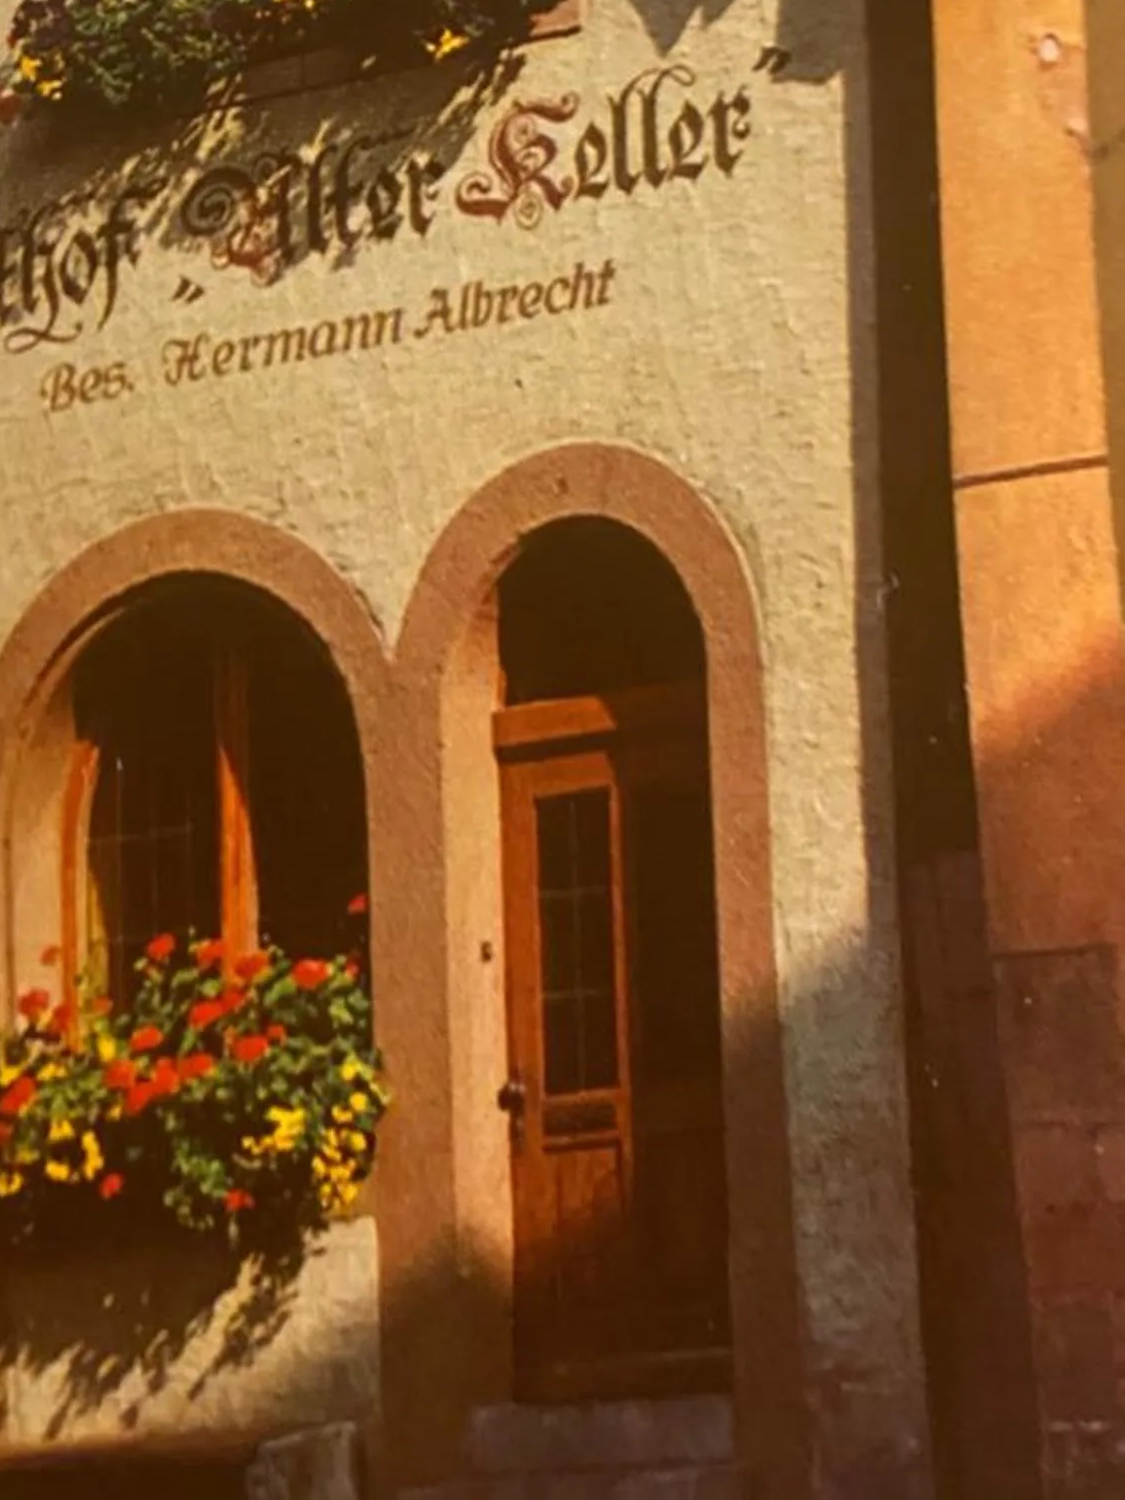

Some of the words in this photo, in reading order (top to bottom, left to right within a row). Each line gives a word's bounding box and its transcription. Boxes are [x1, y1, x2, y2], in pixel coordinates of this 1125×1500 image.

[39, 361, 134, 414] Bes.
[161, 306, 403, 387] Hermann
[413, 258, 617, 339] Albrecht
